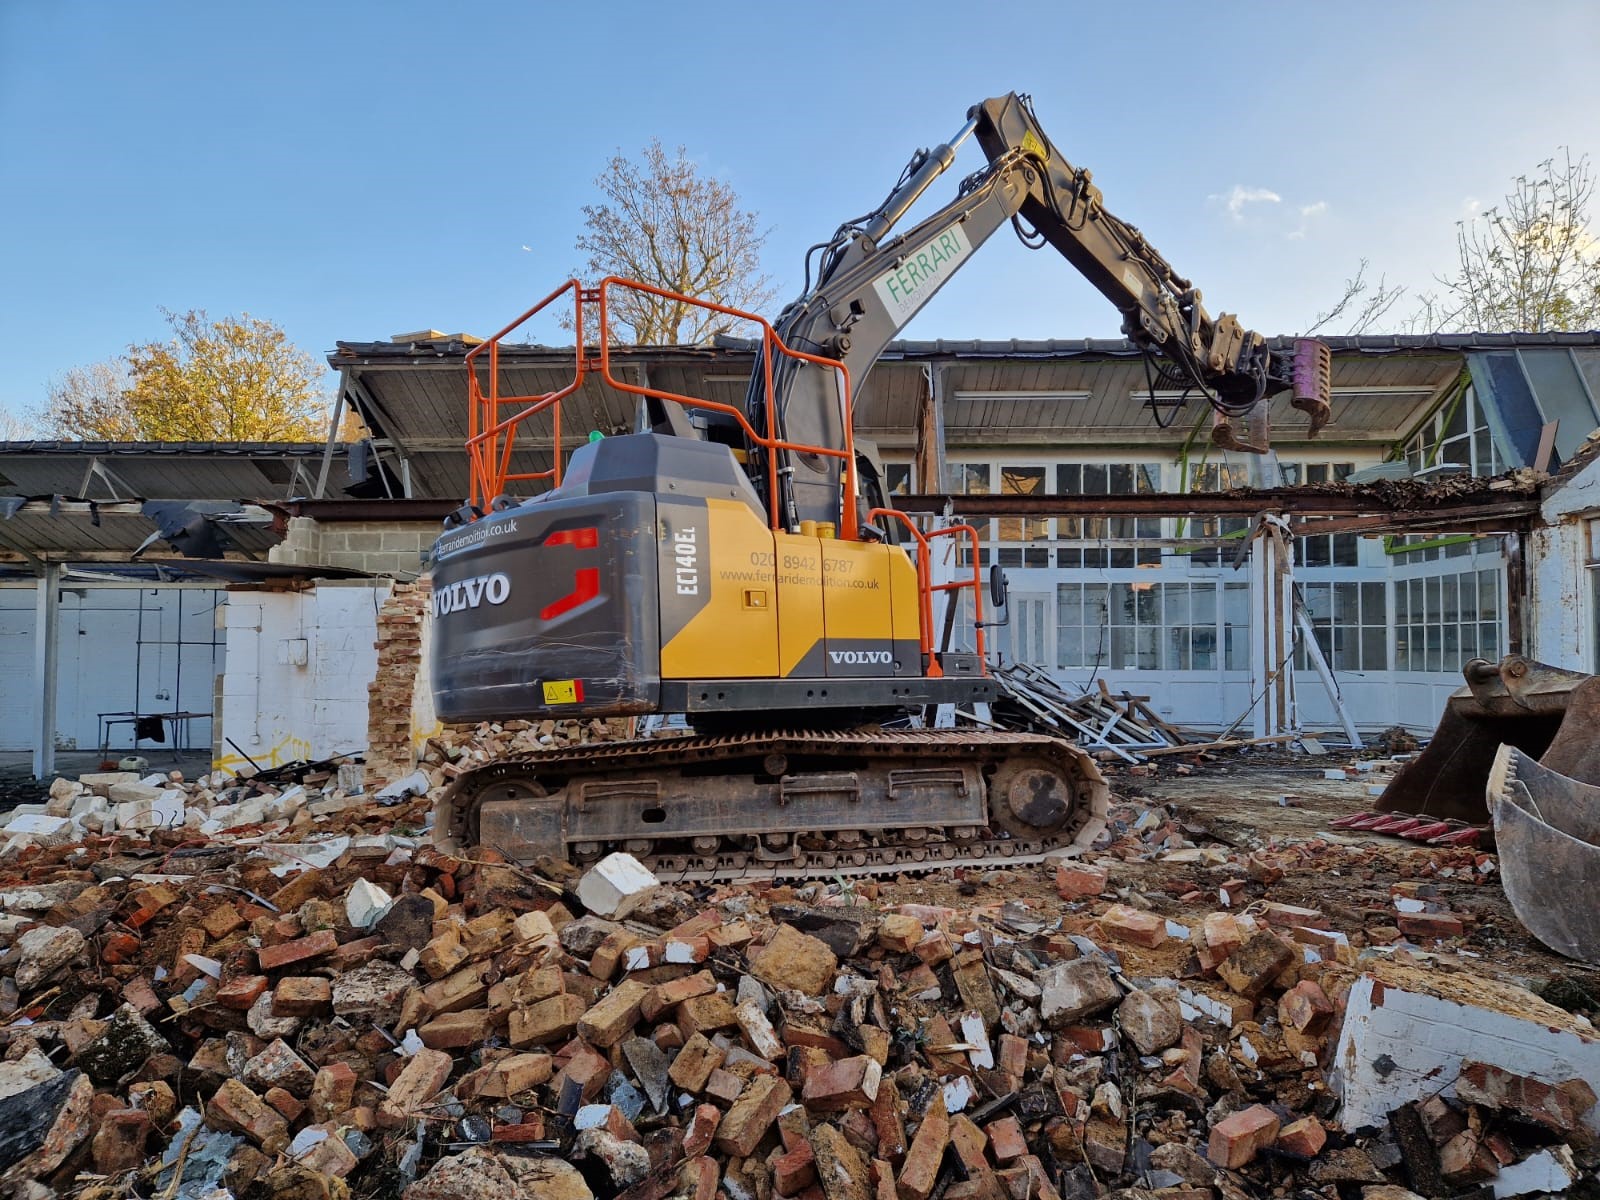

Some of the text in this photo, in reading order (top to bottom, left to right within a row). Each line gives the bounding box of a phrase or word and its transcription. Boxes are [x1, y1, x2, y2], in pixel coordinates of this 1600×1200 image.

[886, 229, 962, 303] FERRARI
[750, 551, 854, 573] 020 8942 6787
[720, 568, 879, 590] www.ferraridemolition.co.uk
[432, 573, 511, 618] VOLVO
[828, 650, 893, 664] VOLVO
